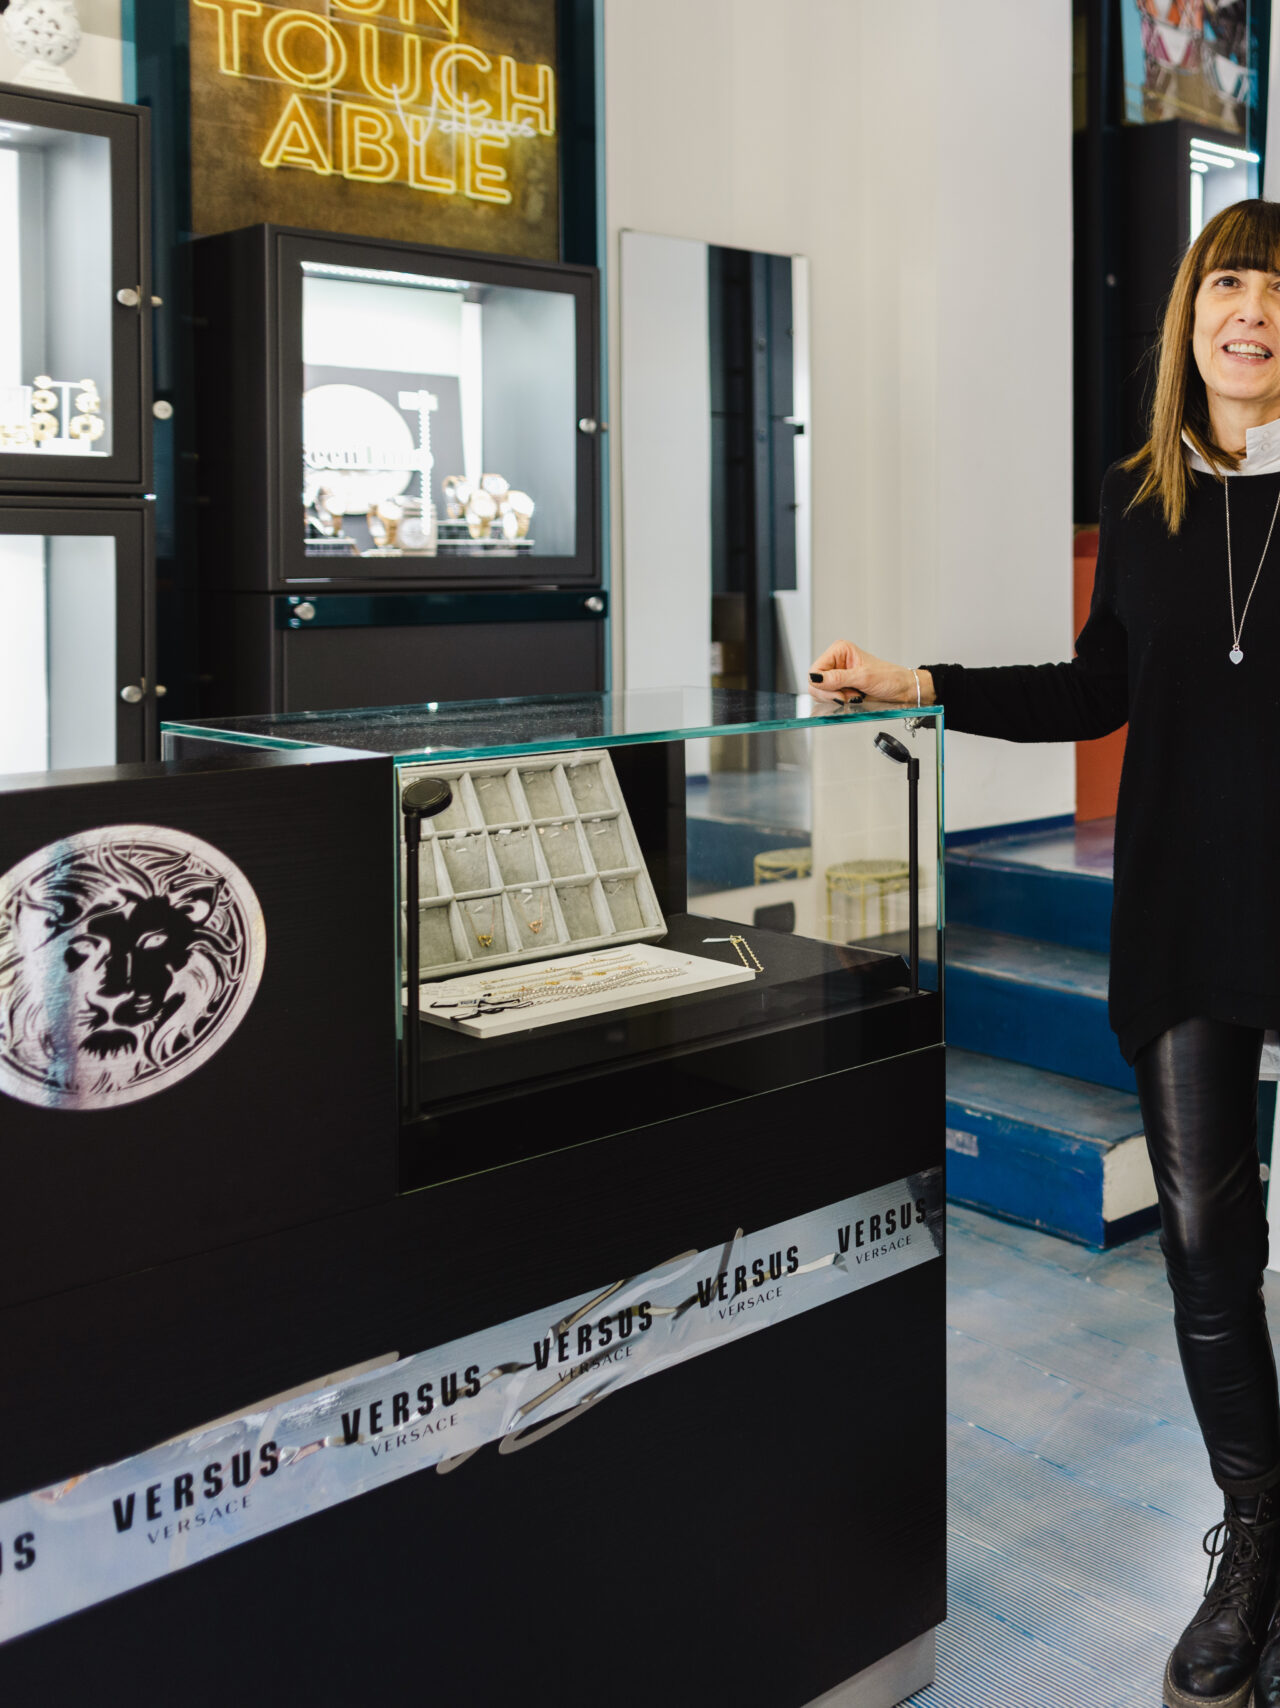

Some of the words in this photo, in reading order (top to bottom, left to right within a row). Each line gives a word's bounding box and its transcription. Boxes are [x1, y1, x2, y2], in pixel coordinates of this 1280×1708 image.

[194, 0, 555, 136] TOUCH
[260, 93, 512, 205] ABLE
[837, 1198, 926, 1254] VERSUS
[855, 1234, 912, 1265] VERSACE
[697, 1245, 799, 1309] VERSUS
[718, 1286, 783, 1320] VERSACE
[533, 1300, 653, 1371] VERSUS
[558, 1346, 633, 1382] VERSACE
[341, 1365, 481, 1446] VERSUS
[371, 1413, 459, 1457] VERSACE
[112, 1440, 279, 1533] VERSUS
[147, 1494, 251, 1545] VERSACE
